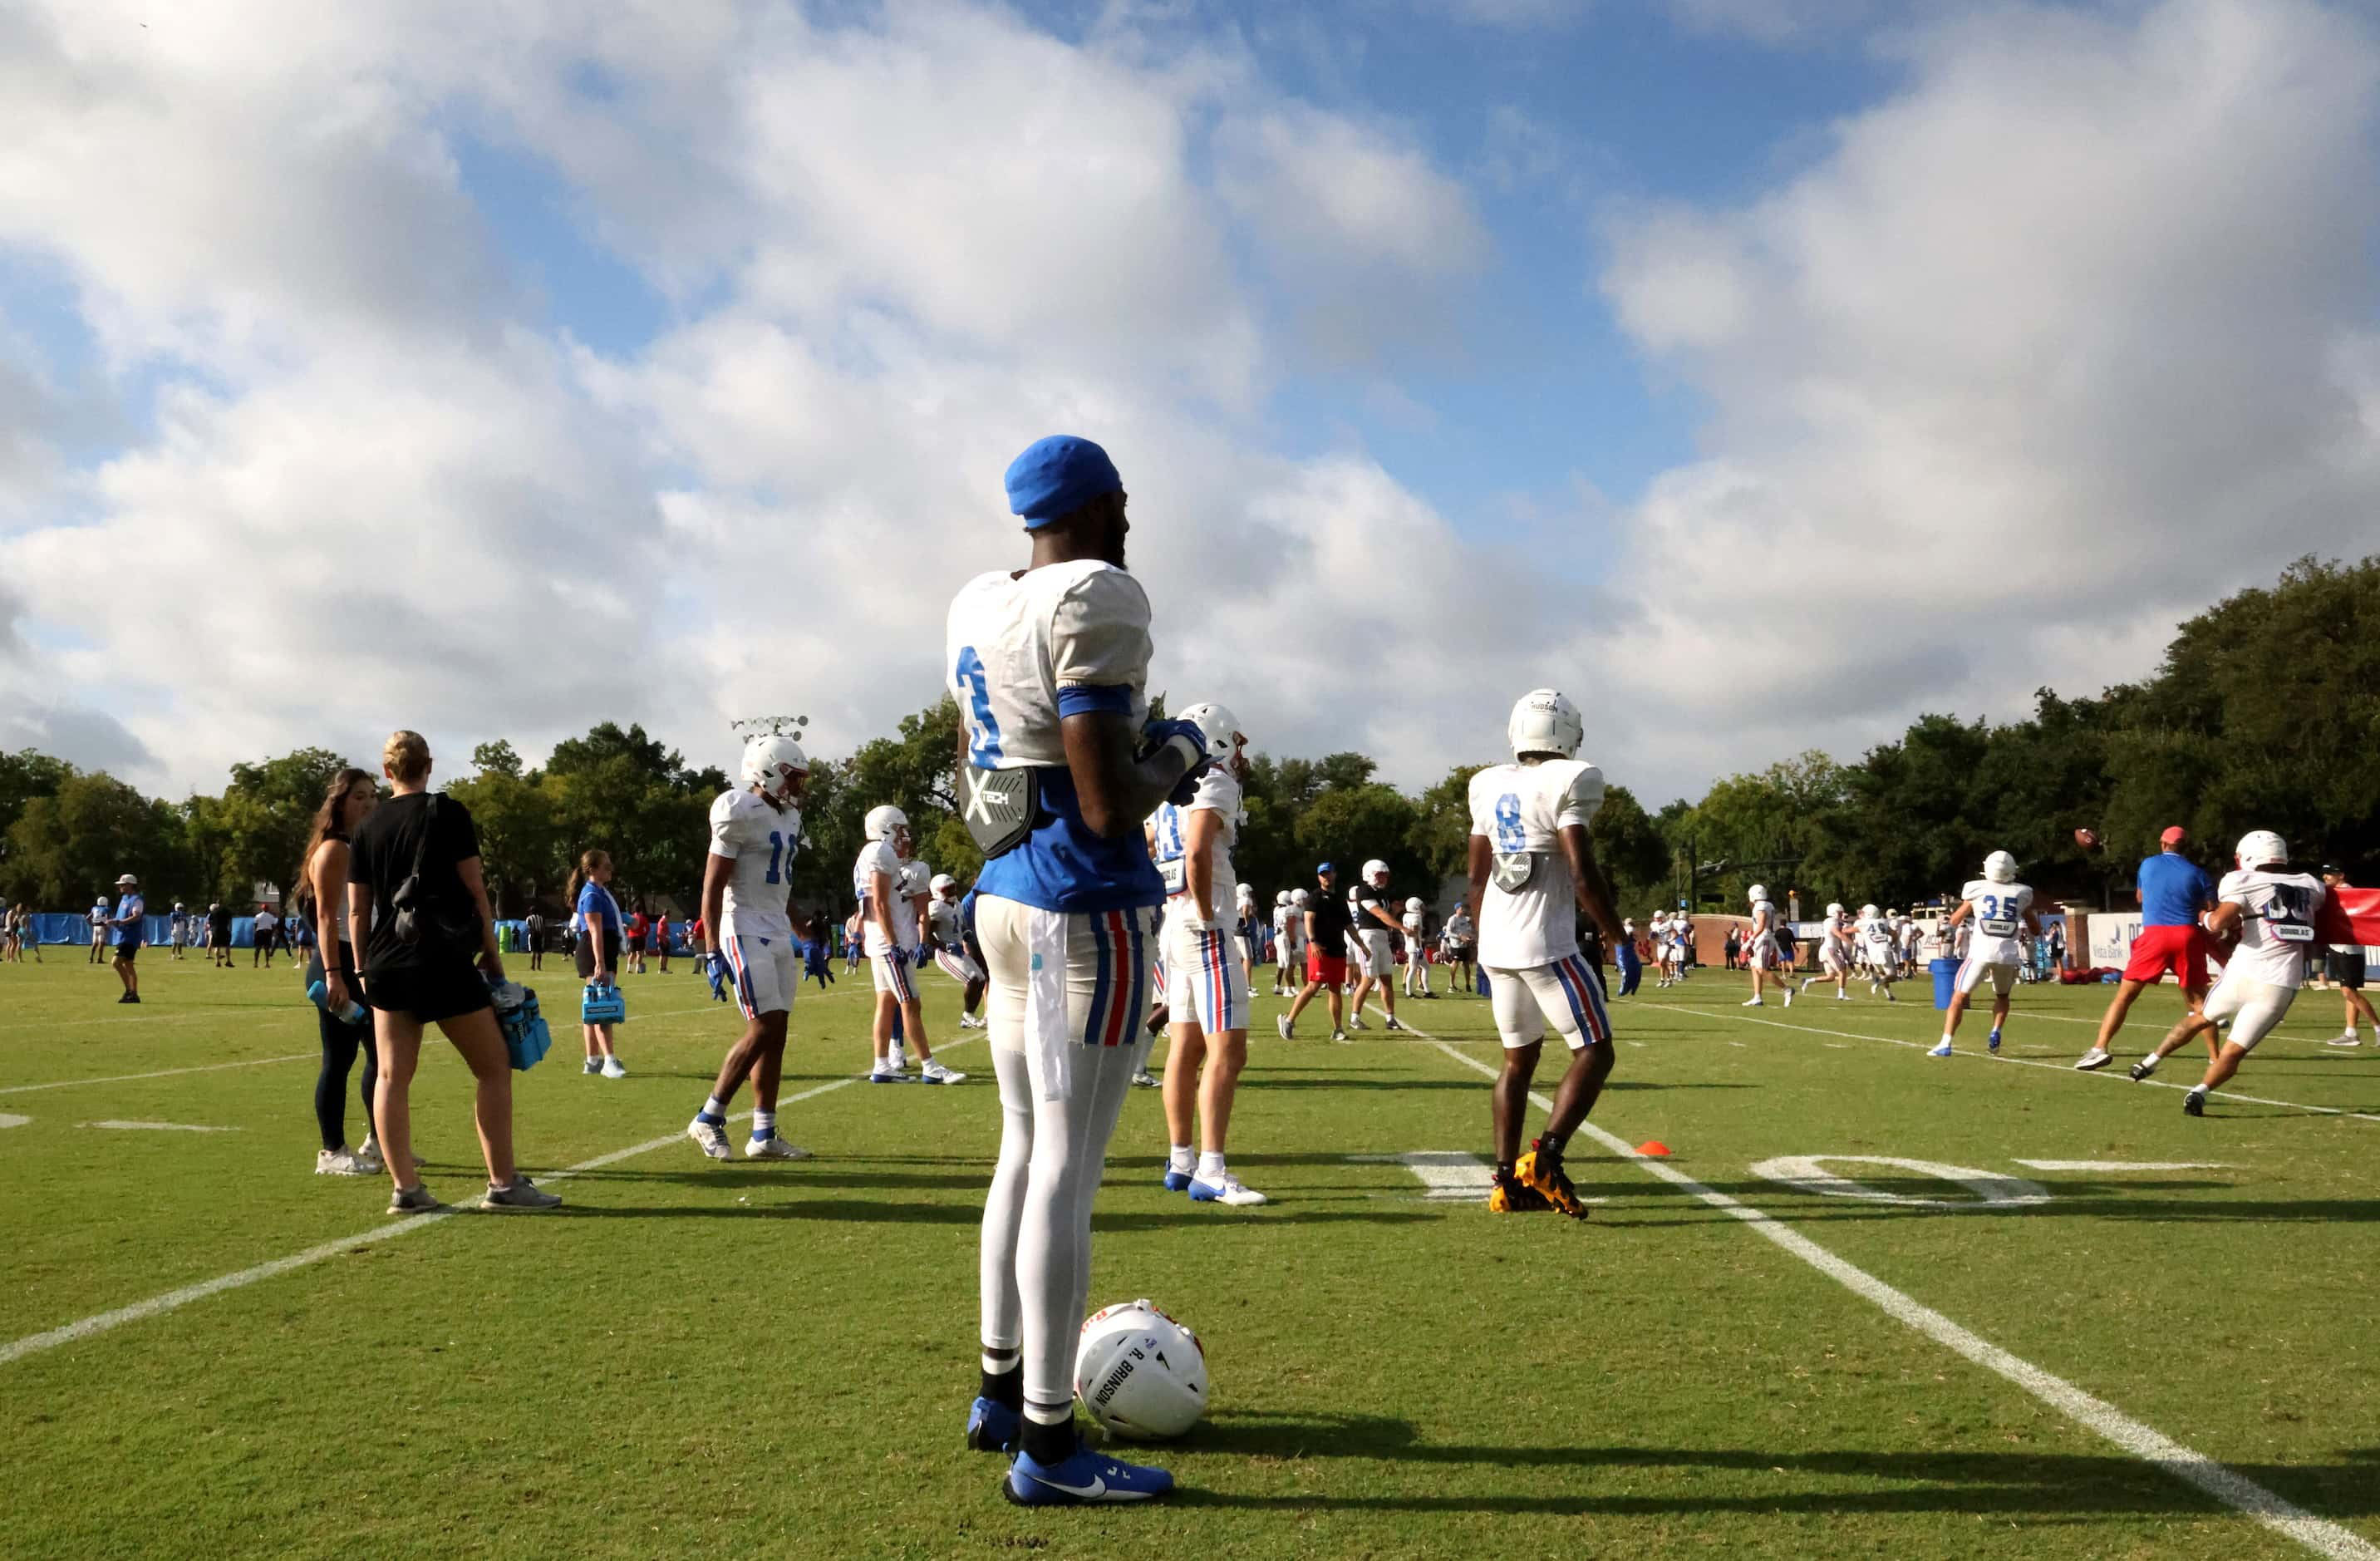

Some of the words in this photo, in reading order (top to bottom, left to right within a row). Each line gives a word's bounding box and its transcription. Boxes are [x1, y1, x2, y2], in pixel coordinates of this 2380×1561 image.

[956, 646, 1005, 771] 3
[1495, 793, 1527, 853] 8
[1981, 894, 2018, 921] 35
[1129, 1347, 1145, 1361] R.
[1094, 1359, 1134, 1407] BRINSON
